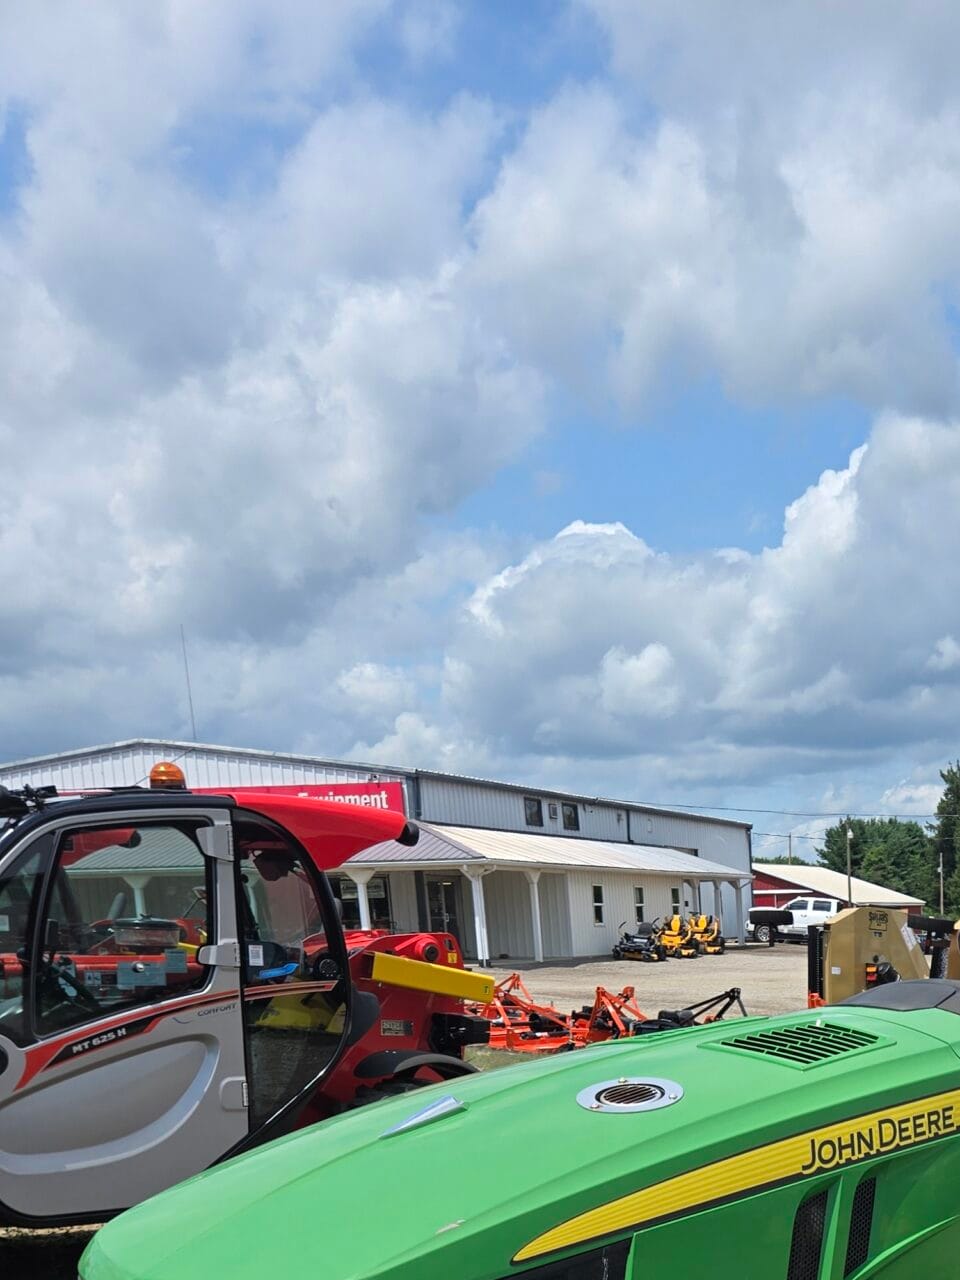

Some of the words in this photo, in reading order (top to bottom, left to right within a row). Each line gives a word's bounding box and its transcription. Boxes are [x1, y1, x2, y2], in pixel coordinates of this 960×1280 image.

[298, 791, 388, 809] iment
[72, 1041, 90, 1054] MT
[92, 1032, 116, 1046] 625
[116, 1027, 127, 1037] H
[801, 1127, 875, 1173] JOHN
[876, 1105, 956, 1150] DEERE
